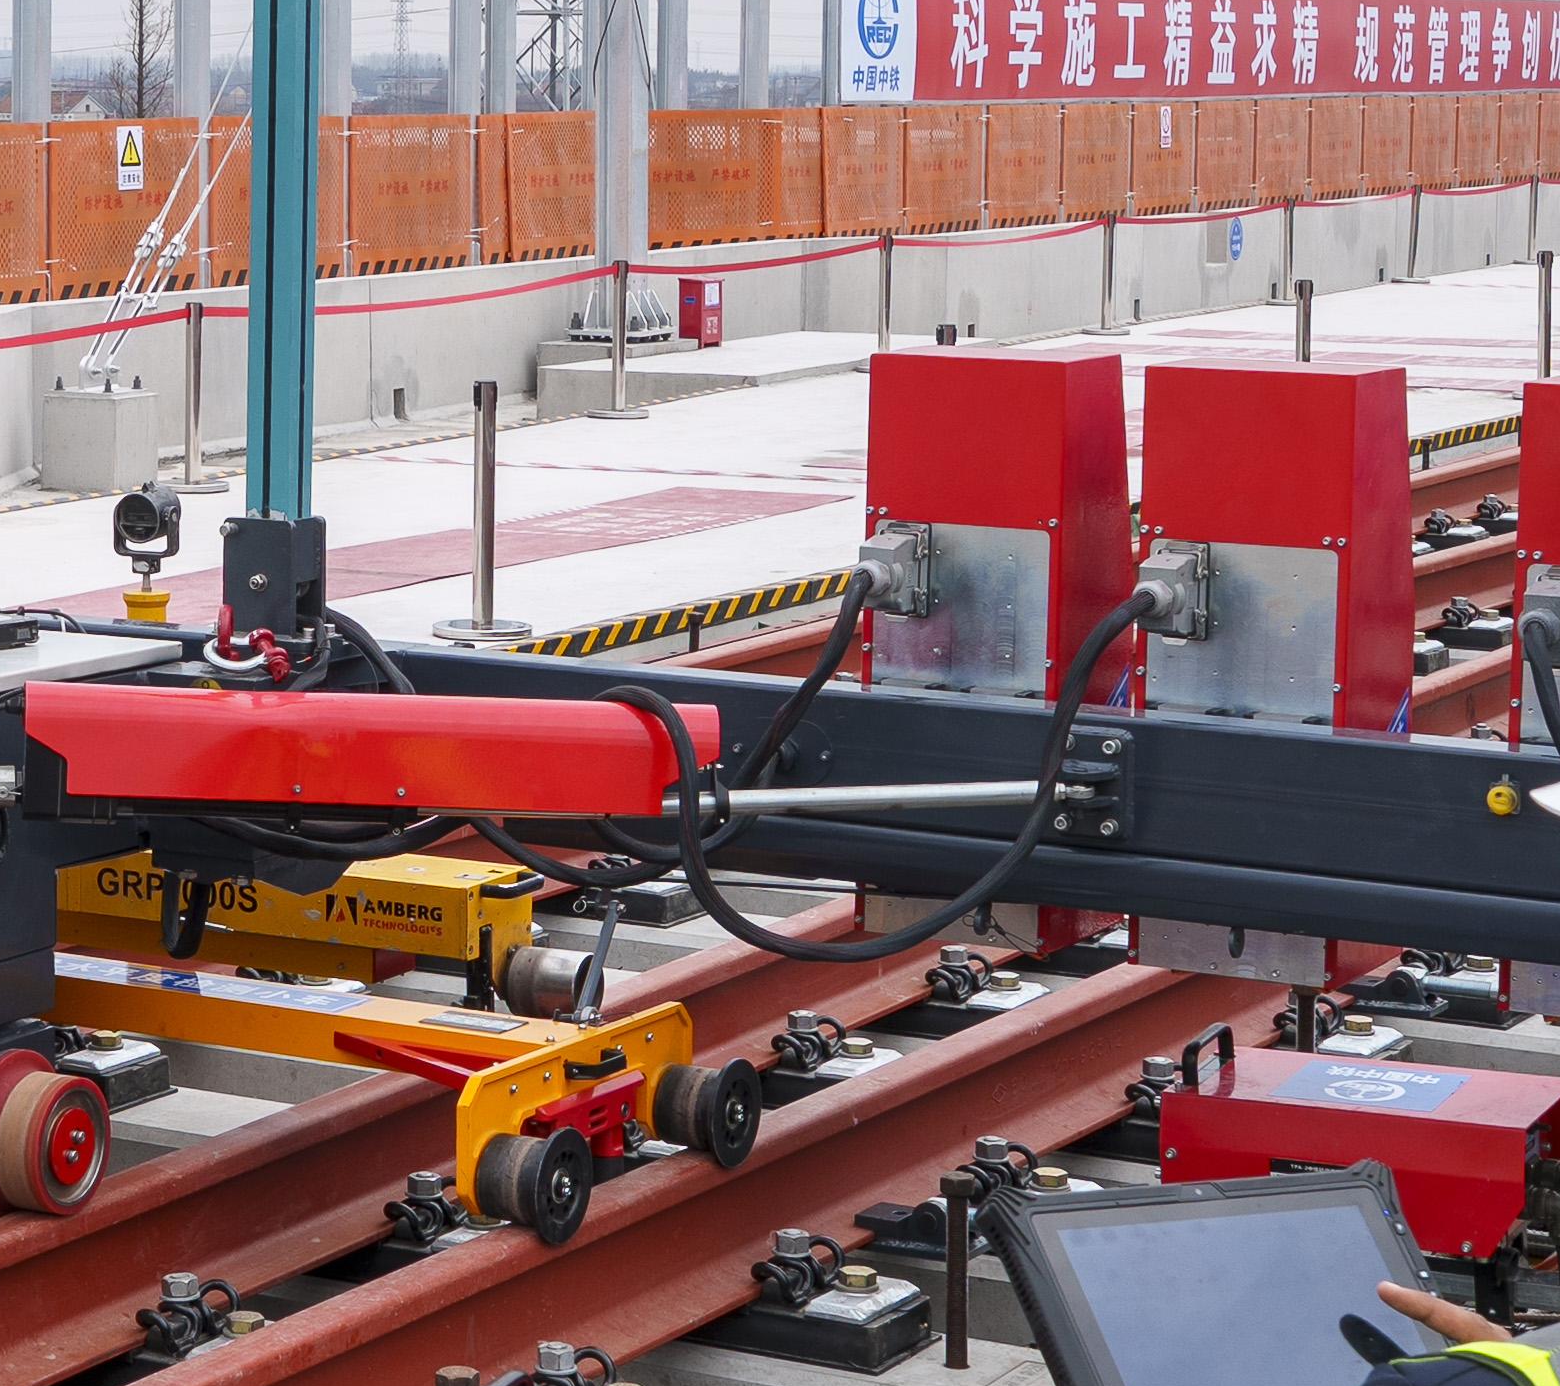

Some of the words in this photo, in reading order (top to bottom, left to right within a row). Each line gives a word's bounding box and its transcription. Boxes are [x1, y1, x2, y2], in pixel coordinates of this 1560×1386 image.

[852, 64, 901, 93] 中国中铁
[96, 867, 259, 914] GRP0S
[363, 898, 443, 923] AMBERG
[54, 955, 342, 1008] 水平度检测小车
[1324, 1064, 1441, 1086] 中国中铁
